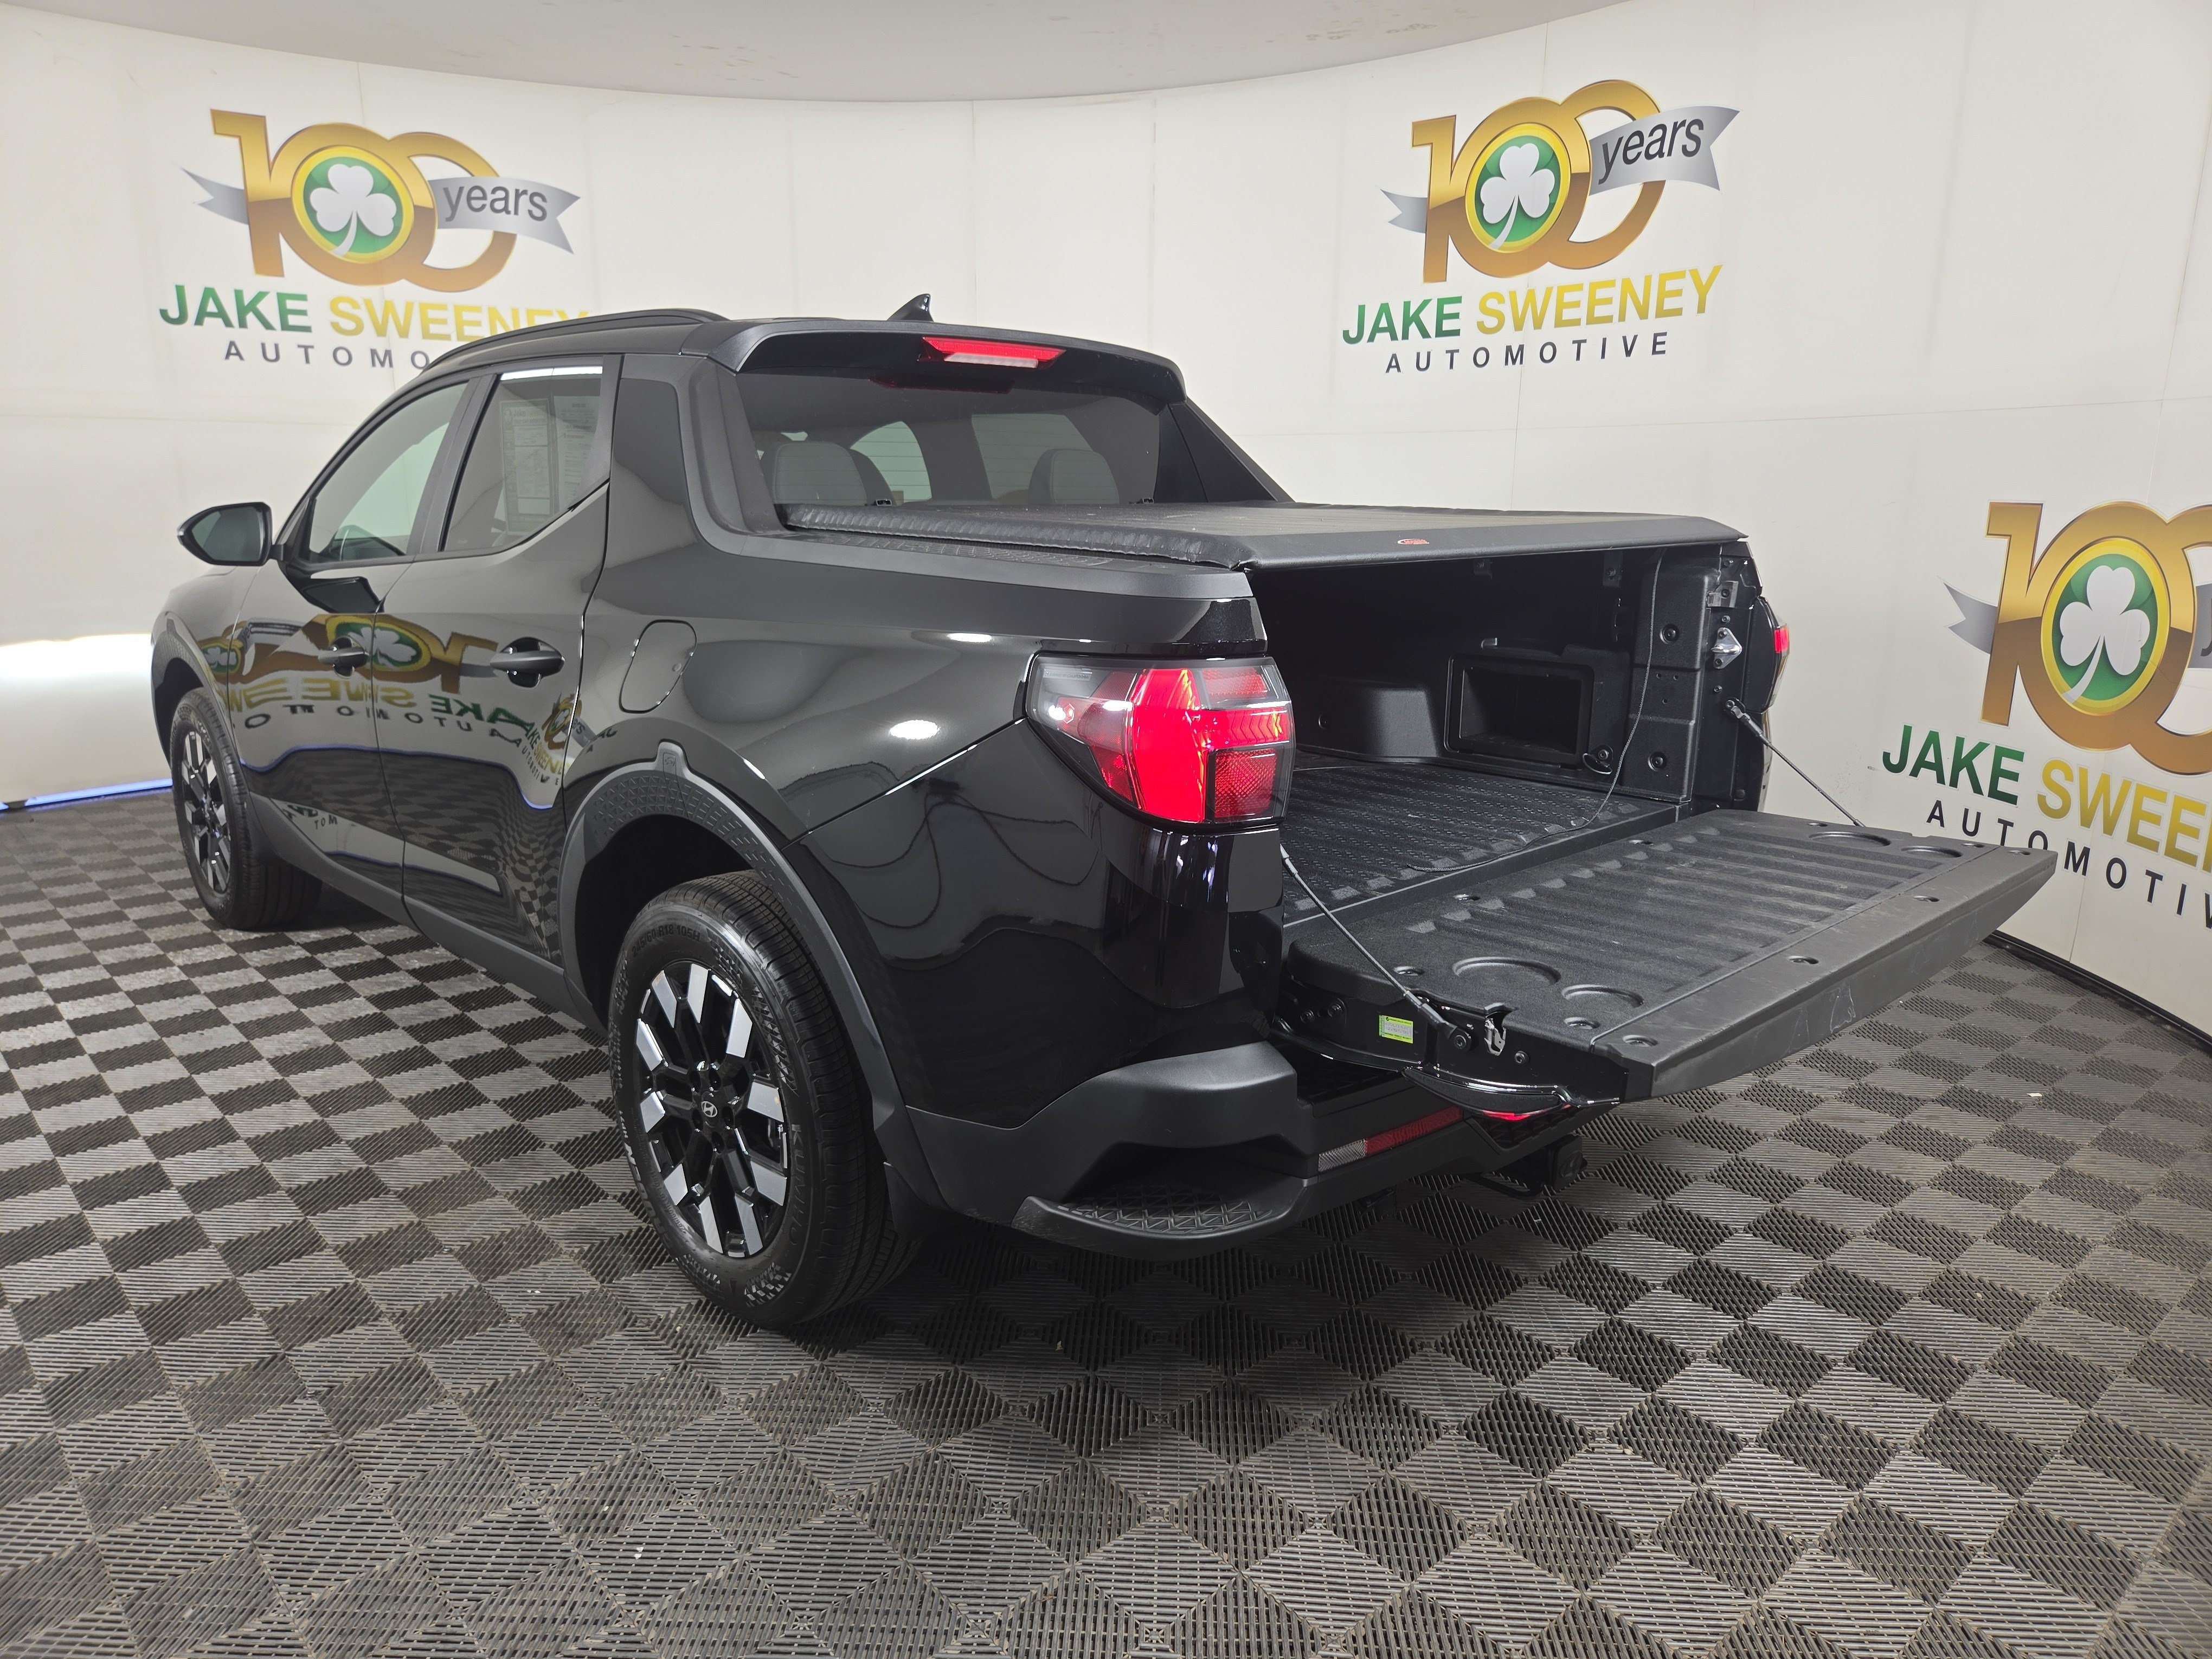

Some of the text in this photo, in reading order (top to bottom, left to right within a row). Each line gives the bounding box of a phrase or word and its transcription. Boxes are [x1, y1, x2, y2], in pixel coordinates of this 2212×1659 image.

[1598, 118, 1704, 184] years
[443, 184, 548, 222] years
[159, 284, 589, 341] JAKE SWEEN
[1342, 265, 1723, 345] JAKE SWEENEY
[224, 340, 430, 370] AUTOMO
[1385, 332, 1668, 374] AUTOMOTIVE
[1882, 724, 2212, 874] JAKE SWEE
[1927, 800, 2212, 929] AUTOMOTI
[658, 924, 674, 937] R18
[677, 924, 701, 942] 105H
[790, 1124, 806, 1245] KUMHO
